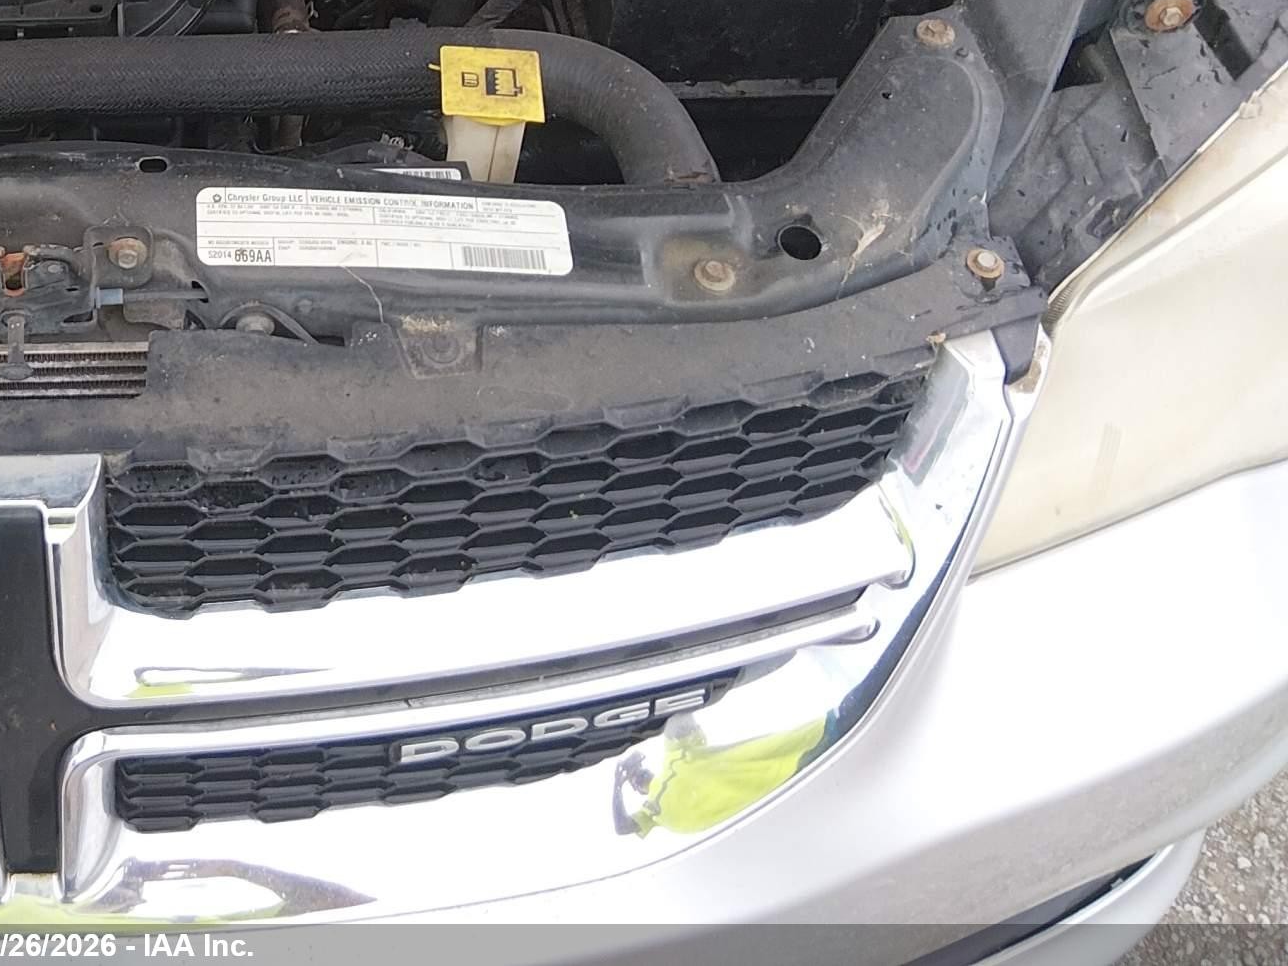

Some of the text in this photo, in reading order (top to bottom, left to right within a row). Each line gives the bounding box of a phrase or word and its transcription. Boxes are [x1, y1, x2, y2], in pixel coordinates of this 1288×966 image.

[227, 193, 304, 204] Chrysler Group LLC
[310, 195, 341, 204] VEHICLE
[344, 196, 381, 206] EMISSION
[383, 198, 417, 207] CONTROL
[418, 200, 474, 210] INFORMATION
[400, 688, 706, 763] DODGE
